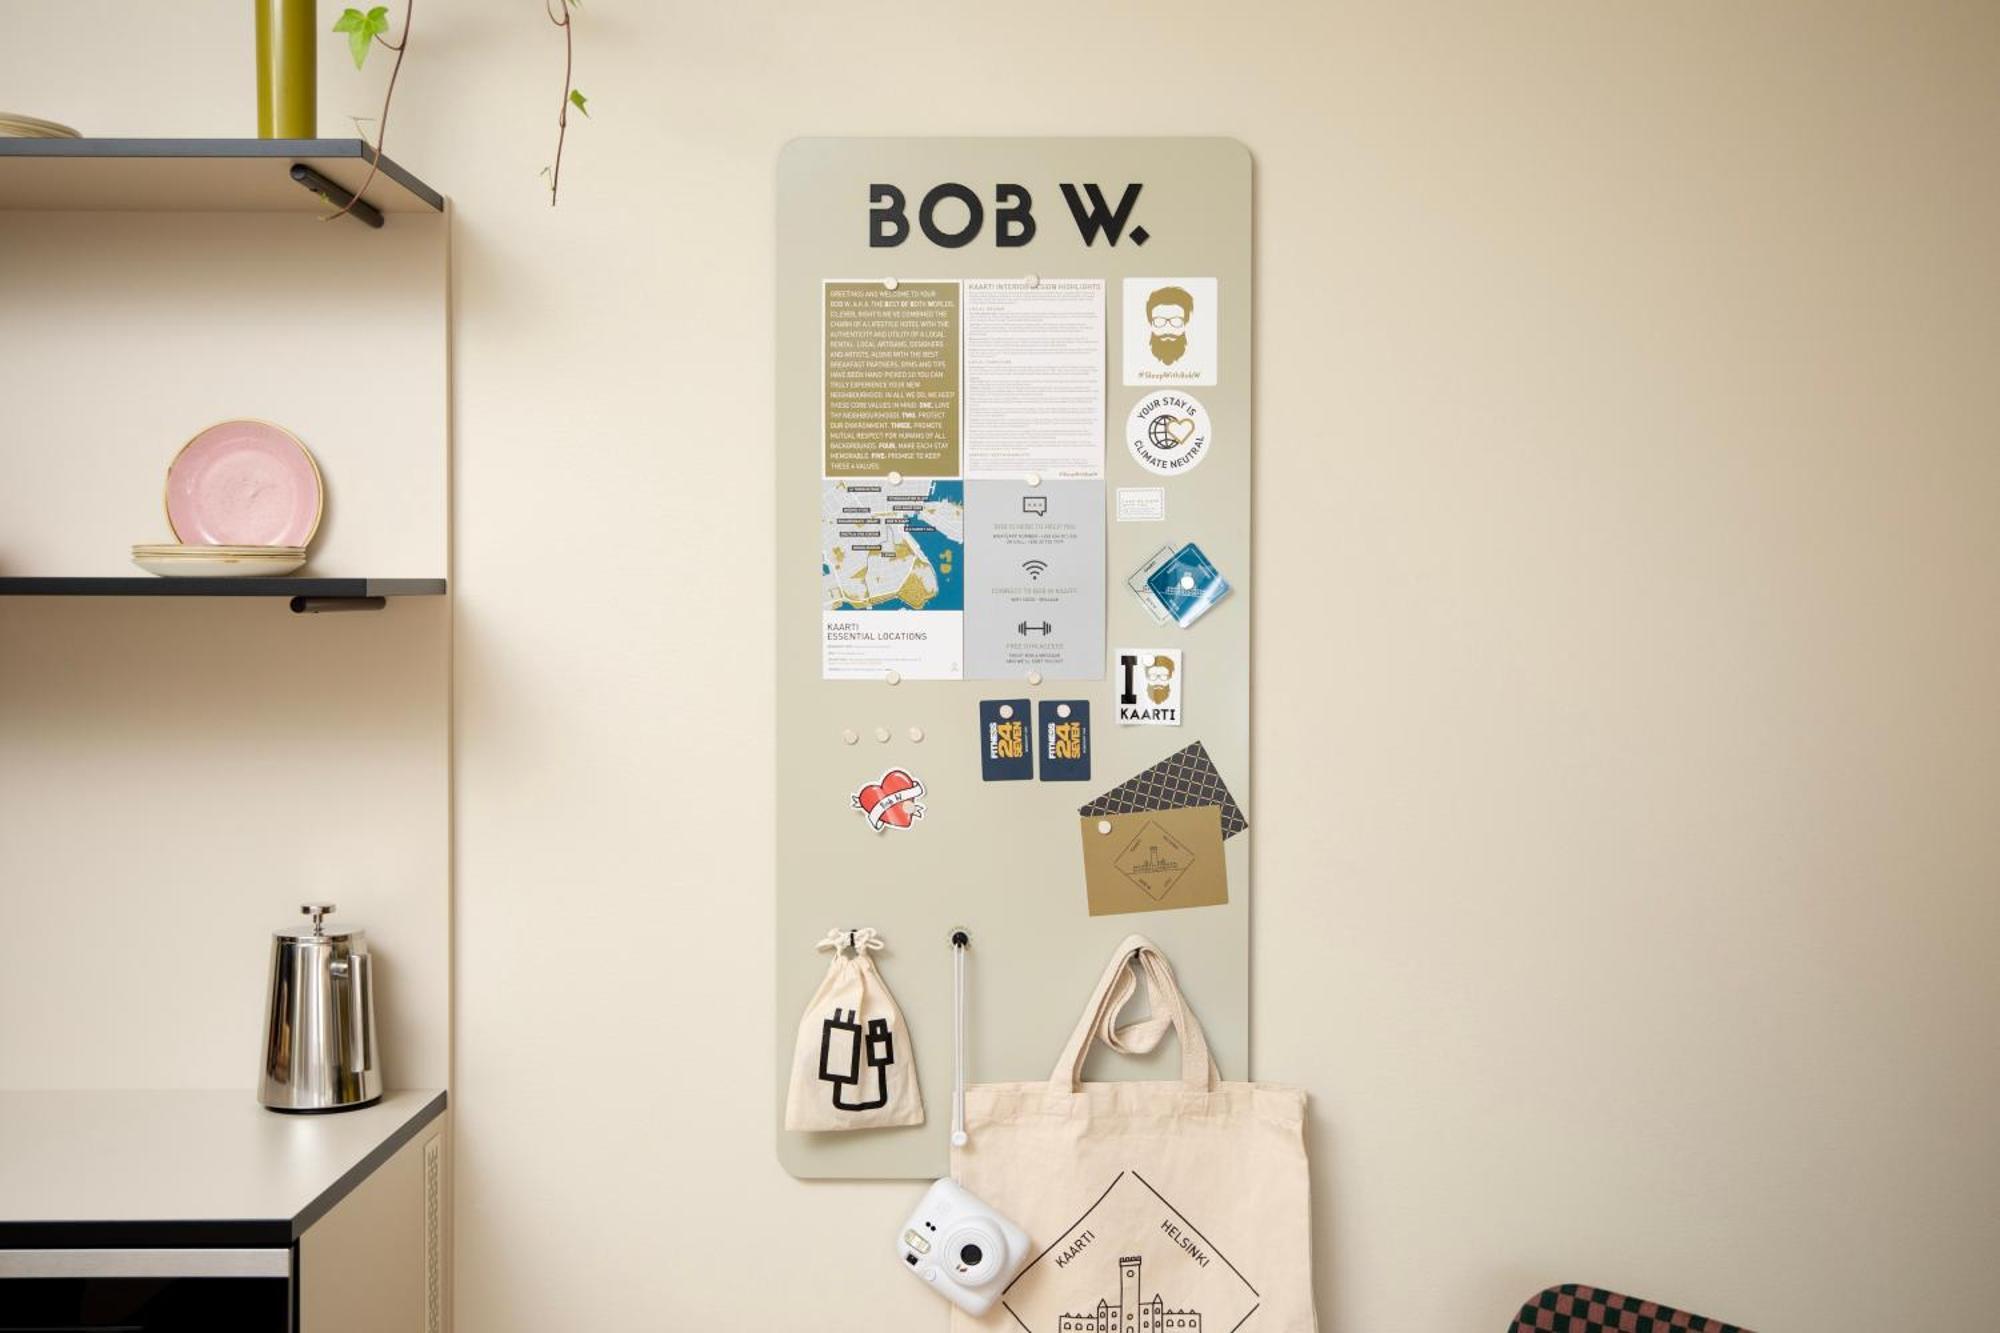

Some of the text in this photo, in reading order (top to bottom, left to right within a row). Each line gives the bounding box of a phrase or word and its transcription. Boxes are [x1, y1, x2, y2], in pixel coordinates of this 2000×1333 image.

[870, 182, 1150, 248] BOB W.
[1137, 396, 1197, 420] YOUR STAY IS
[1134, 440, 1168, 469] CLIMATE
[1170, 436, 1204, 469] NEUTRAL
[1121, 655, 1137, 704] I
[1120, 708, 1175, 721] KAARTI
[989, 722, 998, 759] FITNESS
[998, 722, 1013, 758] 24
[1013, 722, 1023, 758] SEVEN
[1048, 722, 1056, 759] FITNESS
[1056, 722, 1071, 759] 24
[1071, 722, 1080, 759] SEVEN
[1055, 1230, 1096, 1268] KAARTI
[1160, 1219, 1210, 1268] HELSINKI
